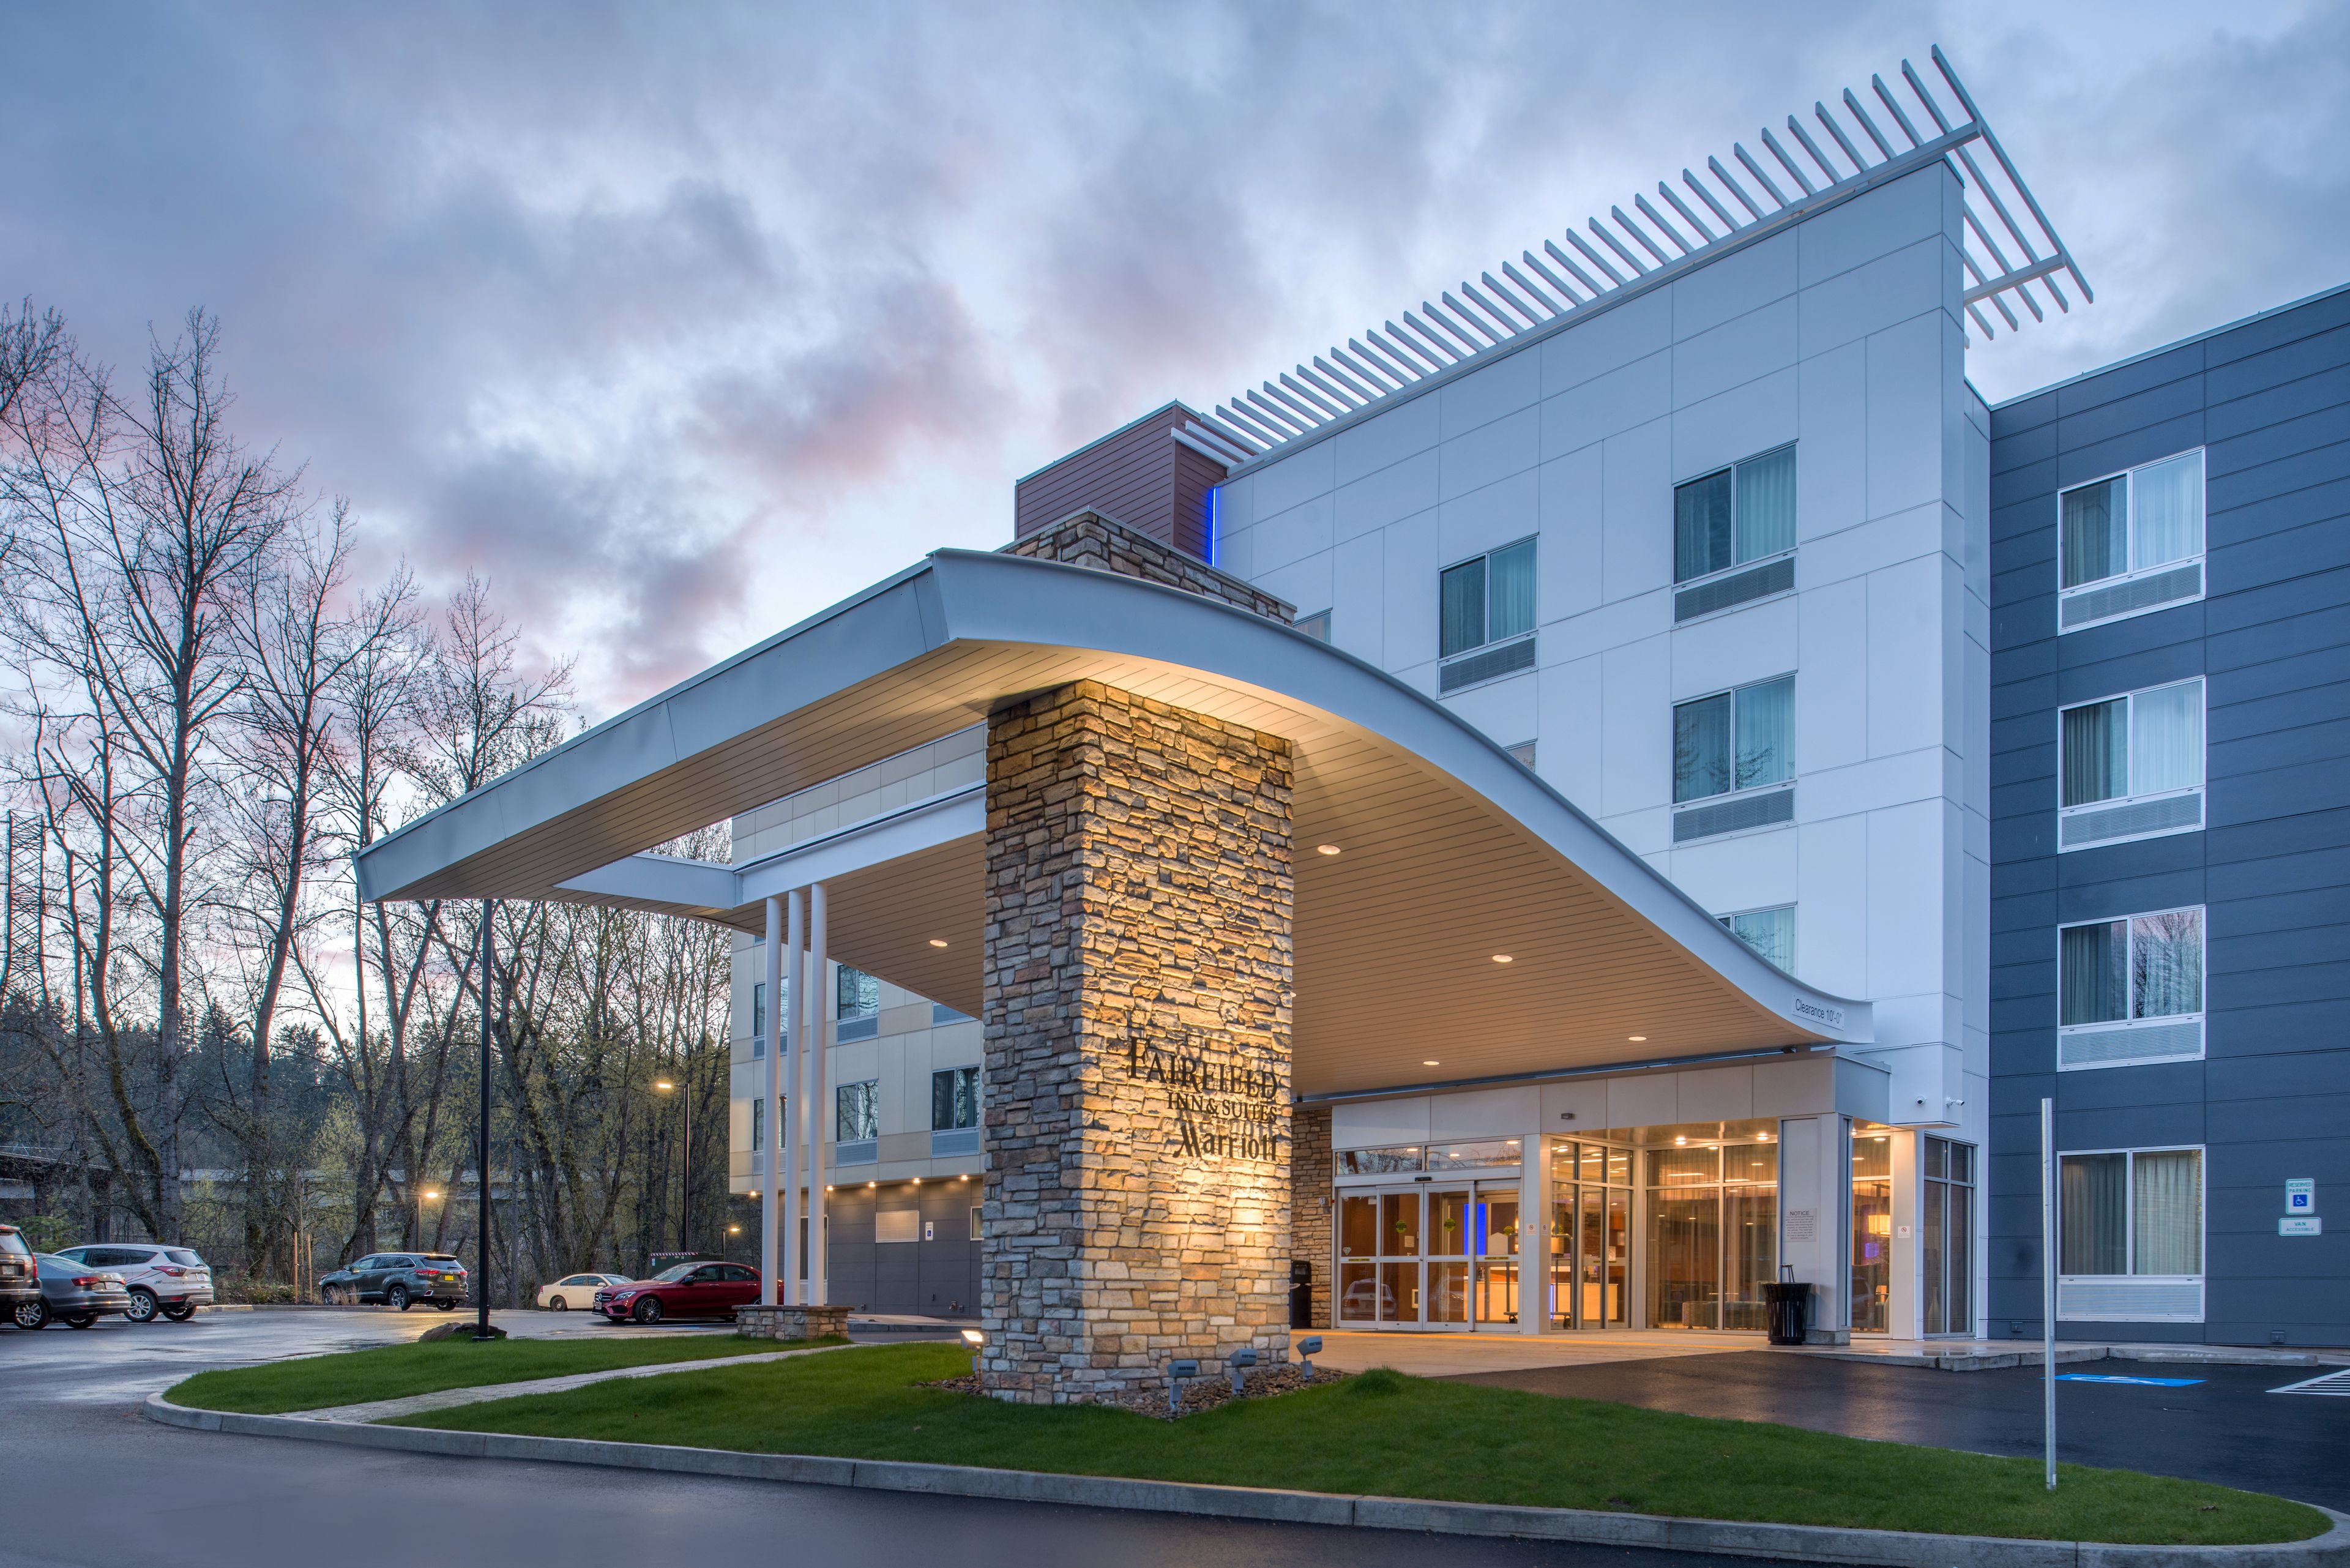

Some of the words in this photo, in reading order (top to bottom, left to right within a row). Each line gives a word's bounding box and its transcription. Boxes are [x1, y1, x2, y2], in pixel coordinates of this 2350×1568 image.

[1796, 999, 1824, 1018] Clearance
[1130, 1037, 1278, 1099] FAIRFIELD
[1167, 1091, 1203, 1113] INN
[1206, 1099, 1220, 1115] &
[1222, 1099, 1278, 1123] SUITES
[1173, 1124, 1278, 1161] Marriott
